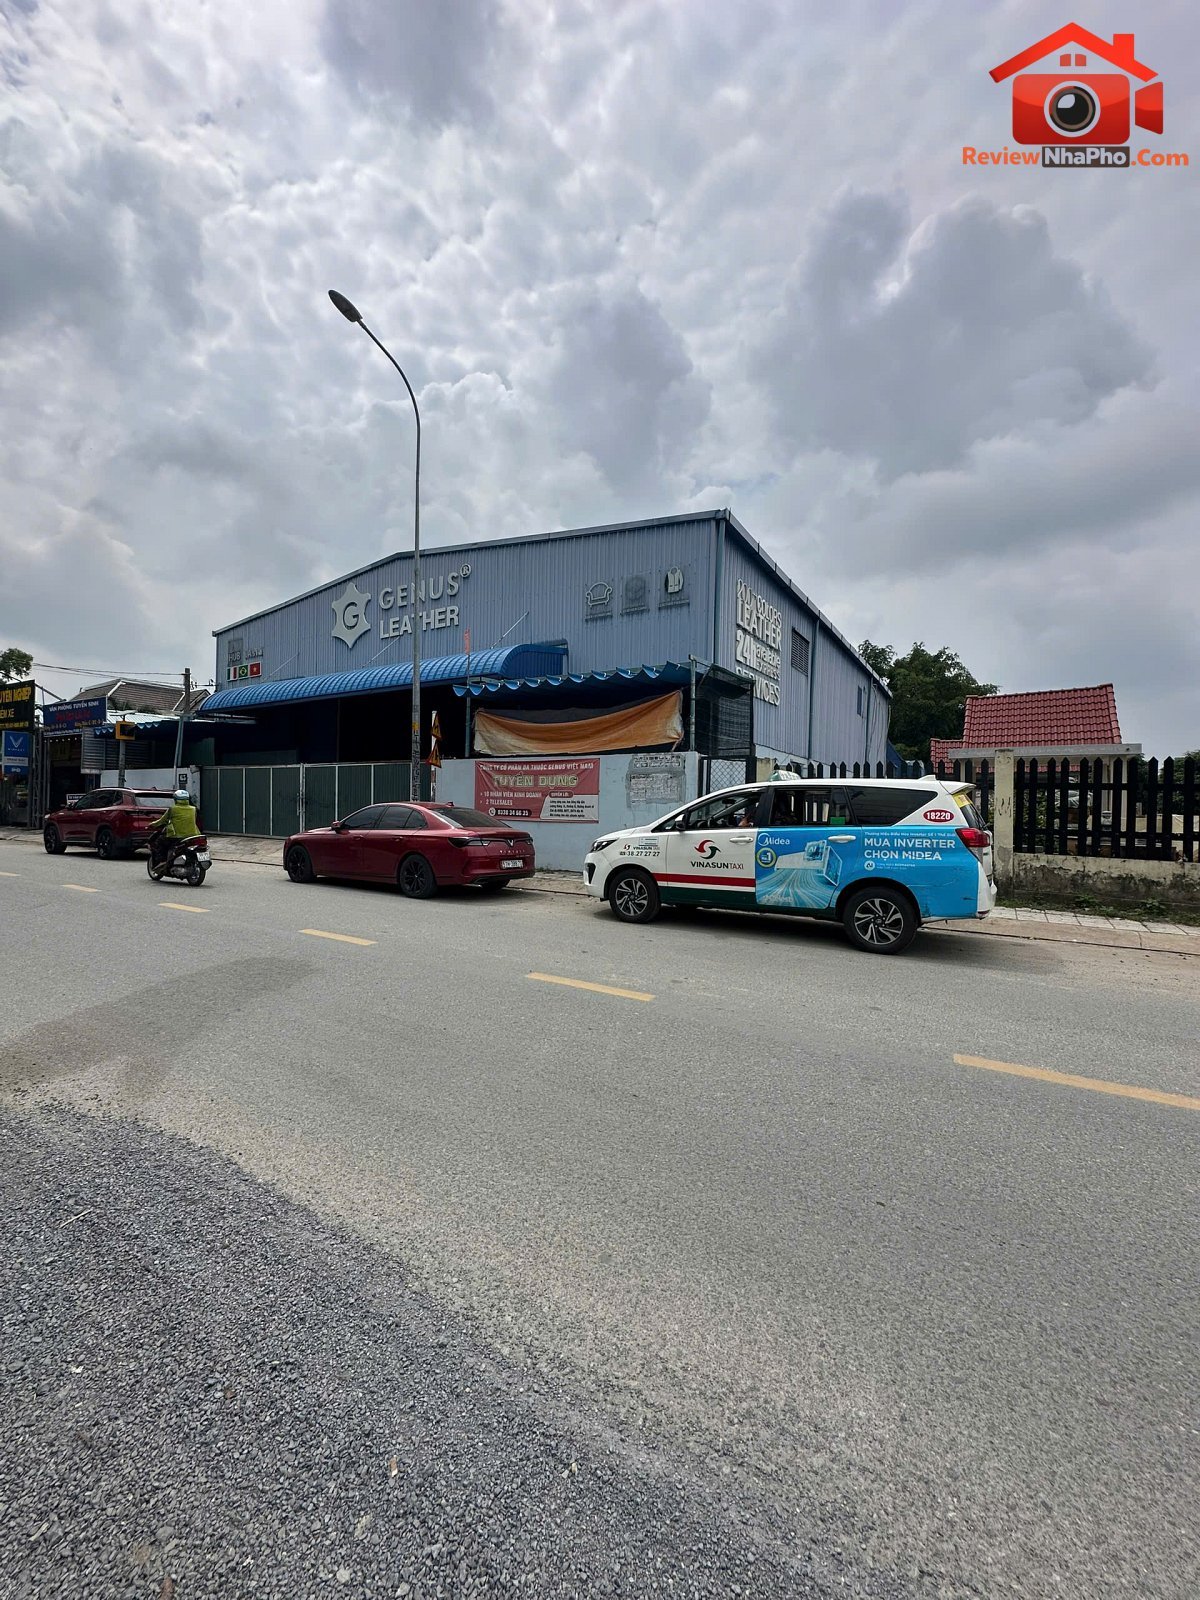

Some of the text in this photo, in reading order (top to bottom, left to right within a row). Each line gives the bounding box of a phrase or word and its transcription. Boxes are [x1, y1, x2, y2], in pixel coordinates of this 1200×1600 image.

[380, 605, 459, 639] LEAHER
[736, 599, 782, 651] LEATHER
[494, 771, 578, 789] TUYỂN DỤNG
[926, 812, 951, 820] 18220
[759, 834, 791, 846] Midea
[864, 838, 956, 848] MUA INVERTER
[864, 849, 942, 861] CHỌN MIDEA
